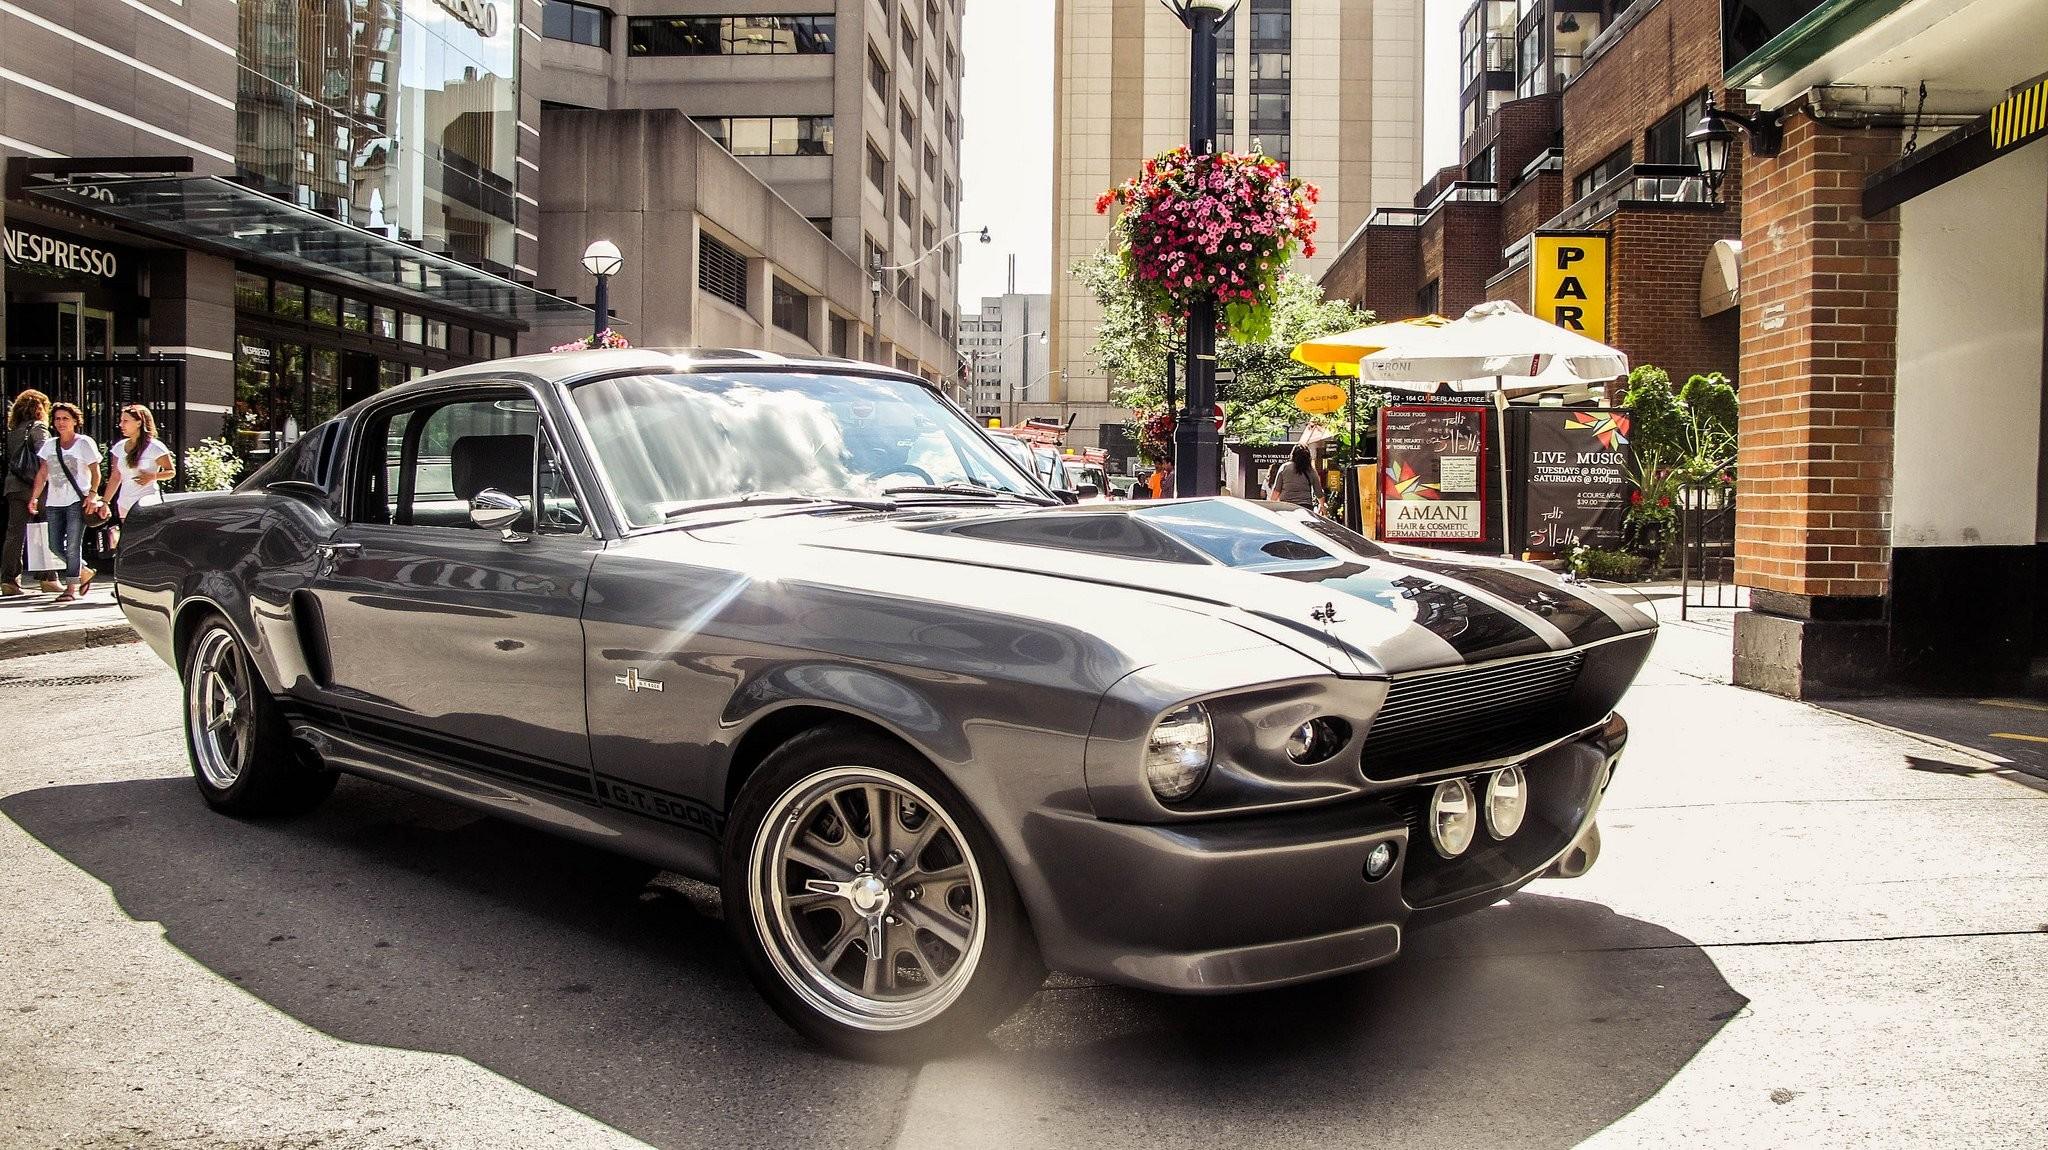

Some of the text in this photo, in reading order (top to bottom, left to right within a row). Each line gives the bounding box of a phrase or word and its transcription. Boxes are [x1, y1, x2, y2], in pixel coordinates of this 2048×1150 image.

[3, 226, 117, 278] NESPRESSO
[1371, 361, 1412, 371] PERONI
[1532, 451, 1624, 465] LIVE MUSIC
[1536, 466, 1619, 477] TUESDAYS @ 8:00pm
[1533, 474, 1622, 485] SATURDAYS @ 9:00pm
[1398, 505, 1469, 521] AMANI
[1396, 522, 1418, 530] HAIR
[1426, 523, 1469, 531] COSMETIC
[1386, 530, 1479, 538] PERMANENT MAKE-UP
